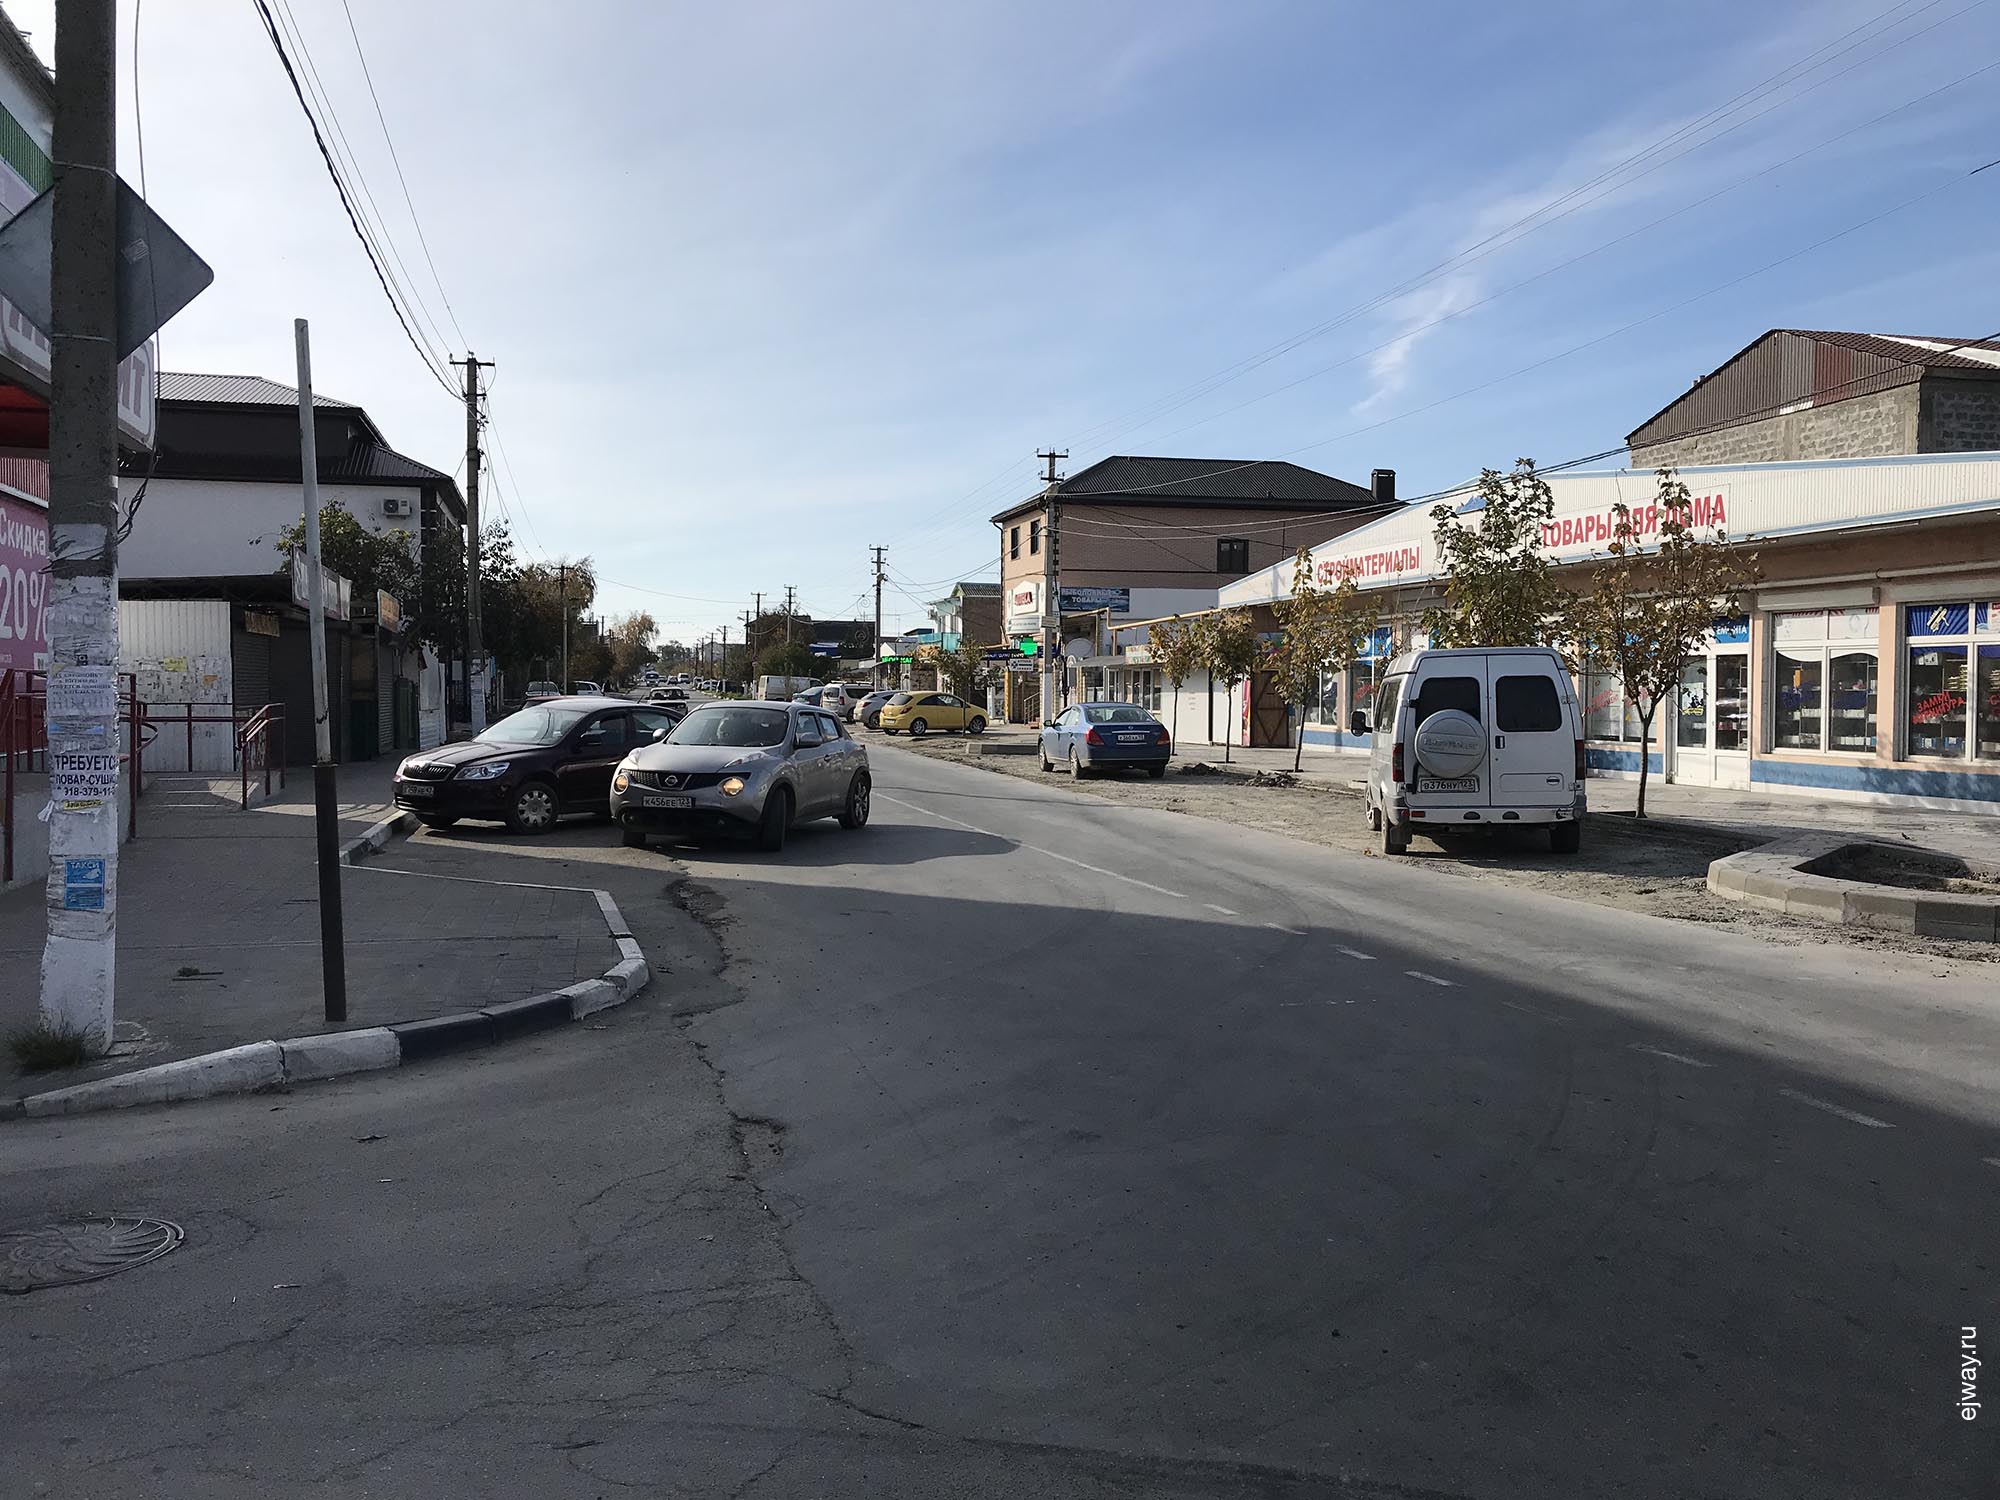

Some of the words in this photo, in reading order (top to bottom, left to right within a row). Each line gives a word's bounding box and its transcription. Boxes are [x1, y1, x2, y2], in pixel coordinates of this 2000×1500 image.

[0, 508, 46, 559] Скидка
[1540, 513, 1612, 548] ТОВАРЫ
[0, 564, 51, 642] 20%
